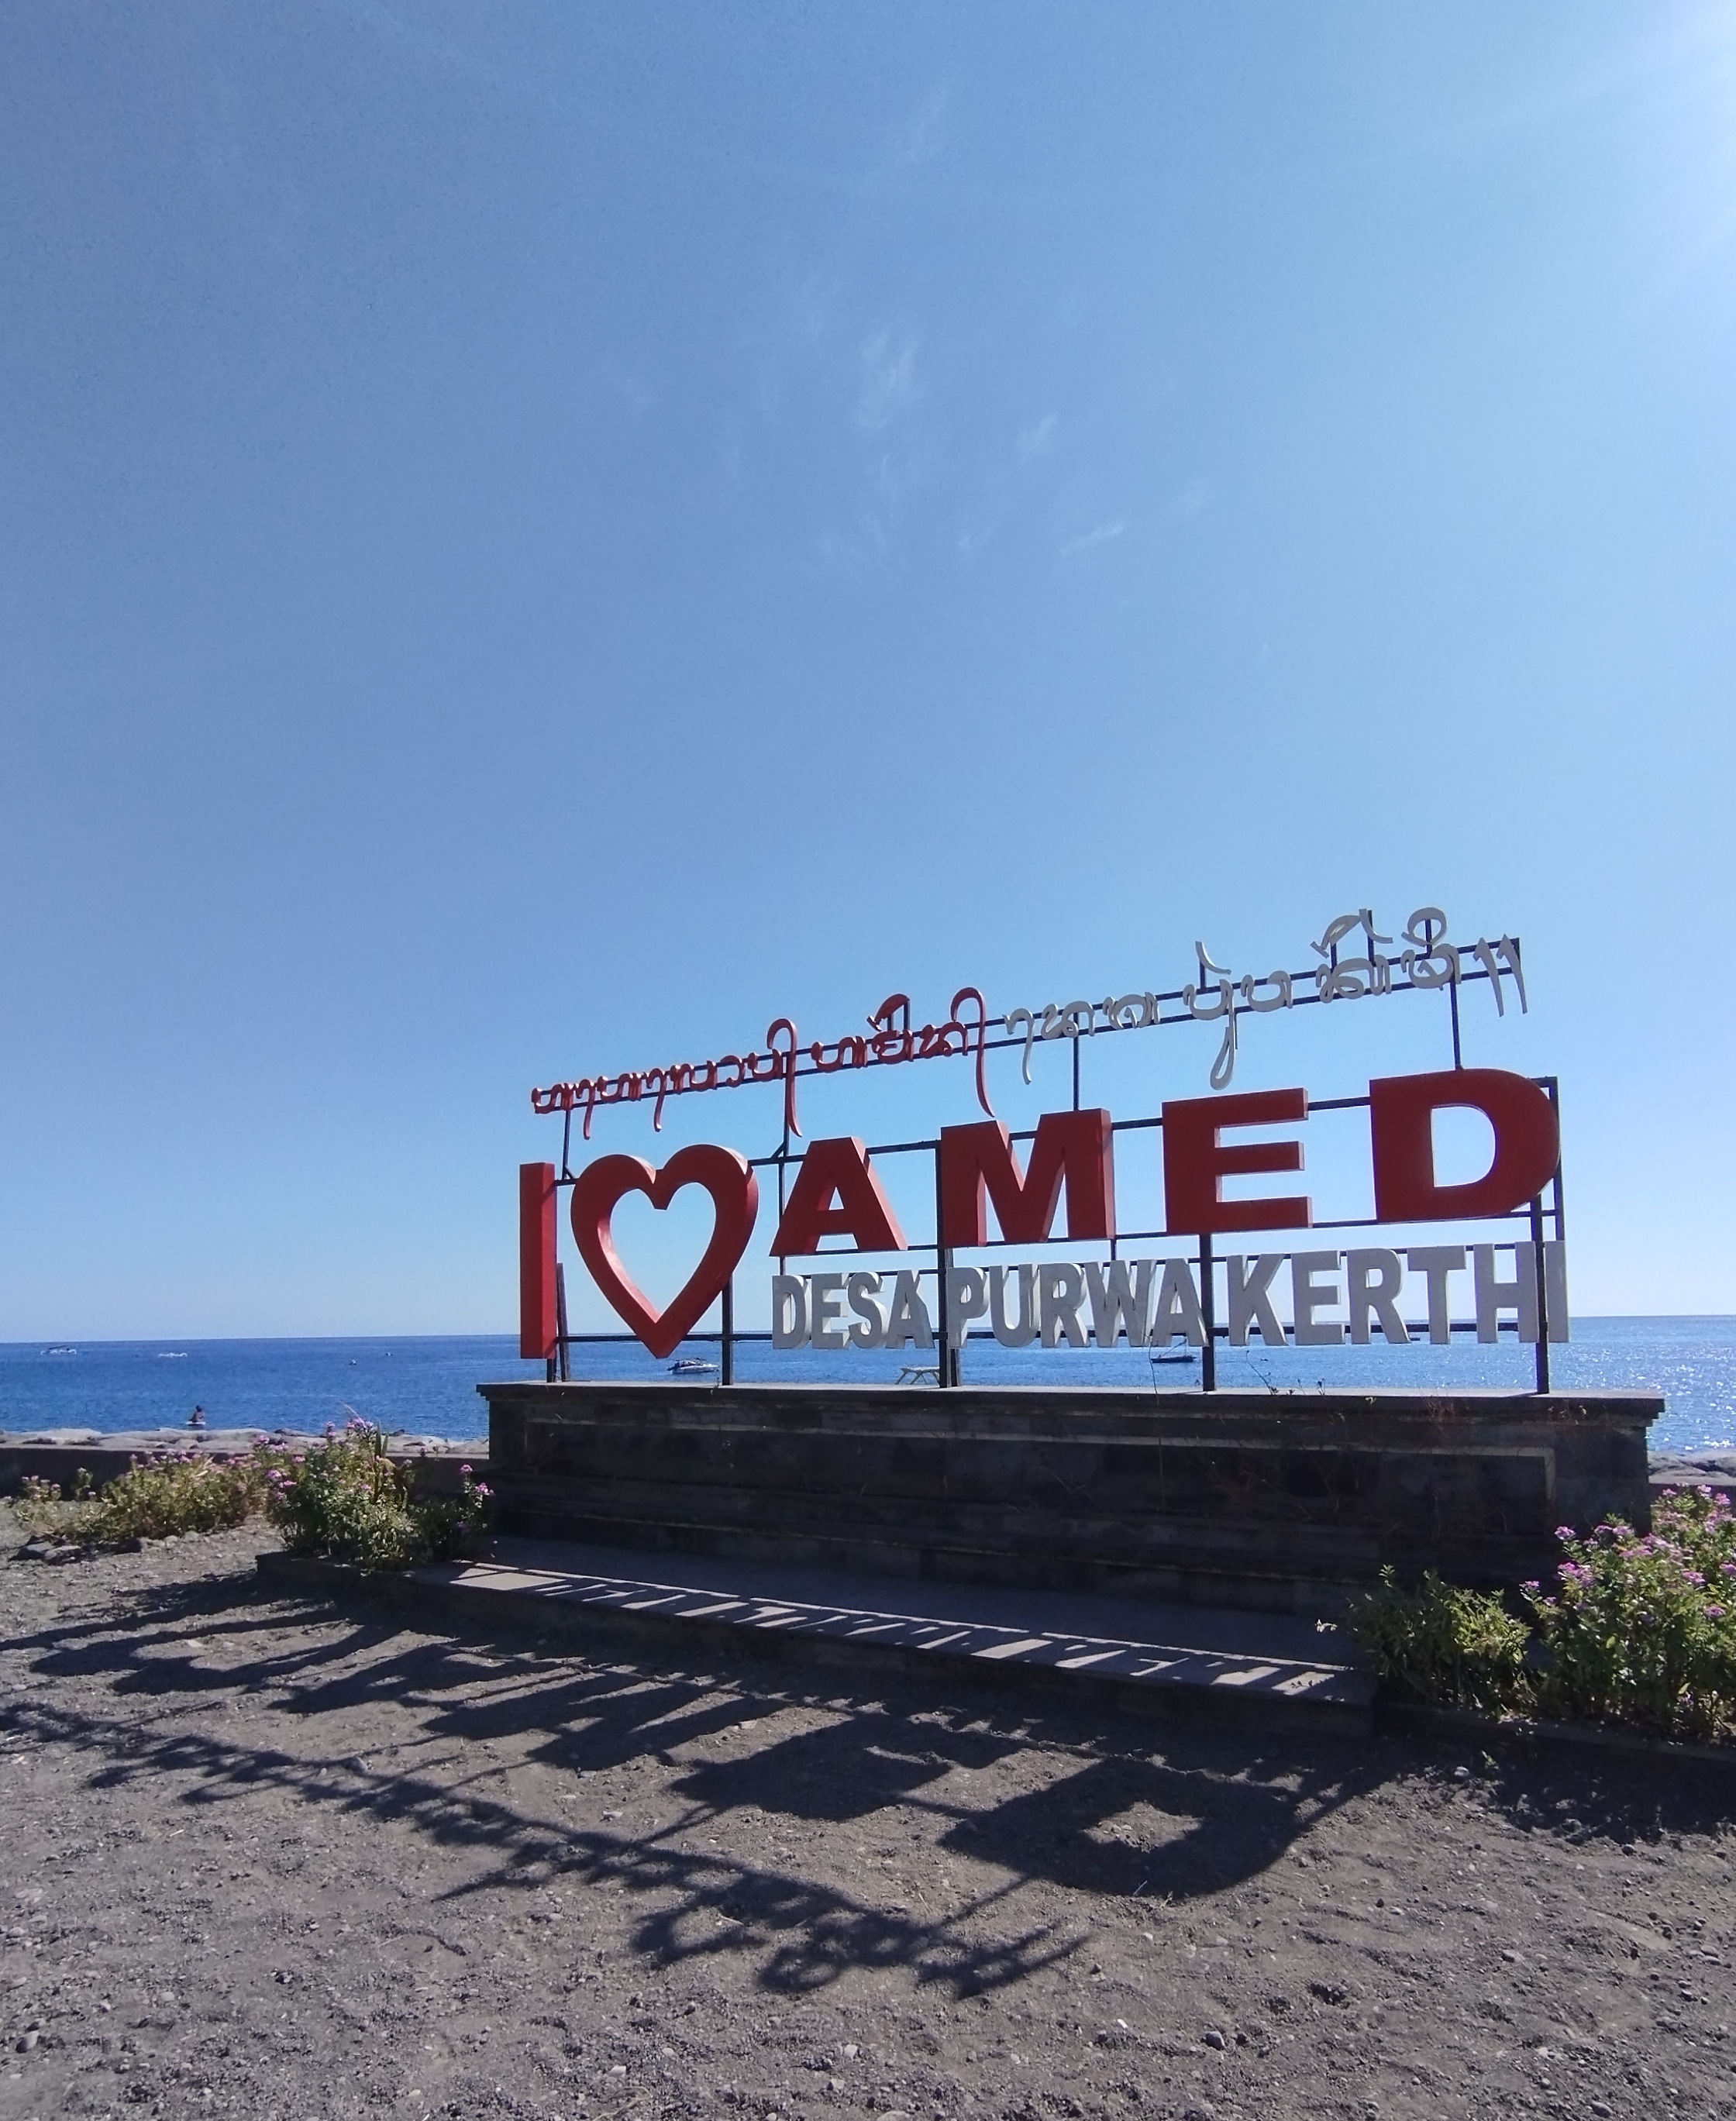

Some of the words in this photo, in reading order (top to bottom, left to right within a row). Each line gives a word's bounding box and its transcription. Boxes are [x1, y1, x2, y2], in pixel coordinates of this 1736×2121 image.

[519, 1162, 557, 1359] I
[769, 1068, 1561, 1257] AMED
[772, 1269, 935, 1350] DESA
